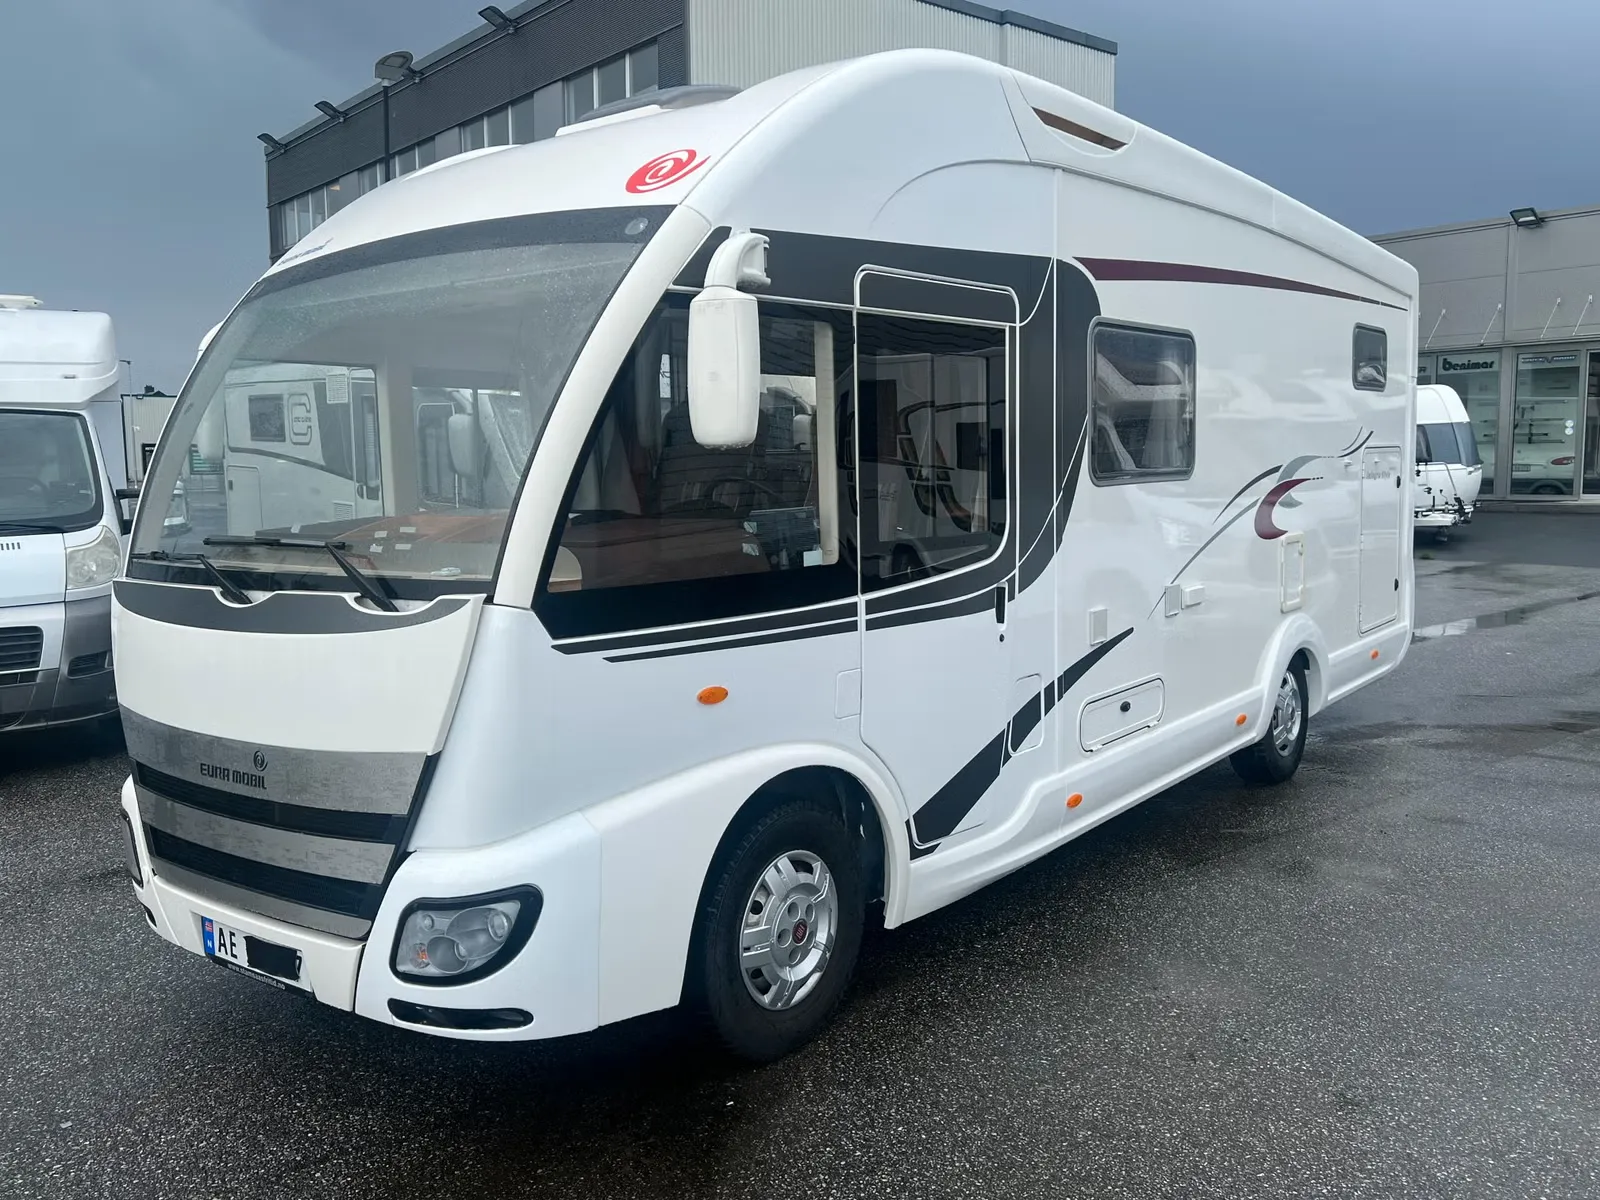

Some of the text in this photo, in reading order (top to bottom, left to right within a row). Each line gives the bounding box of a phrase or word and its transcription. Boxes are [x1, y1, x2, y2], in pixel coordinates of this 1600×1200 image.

[1442, 357, 1495, 372] benimar
[200, 762, 267, 790] EURA MOBIL
